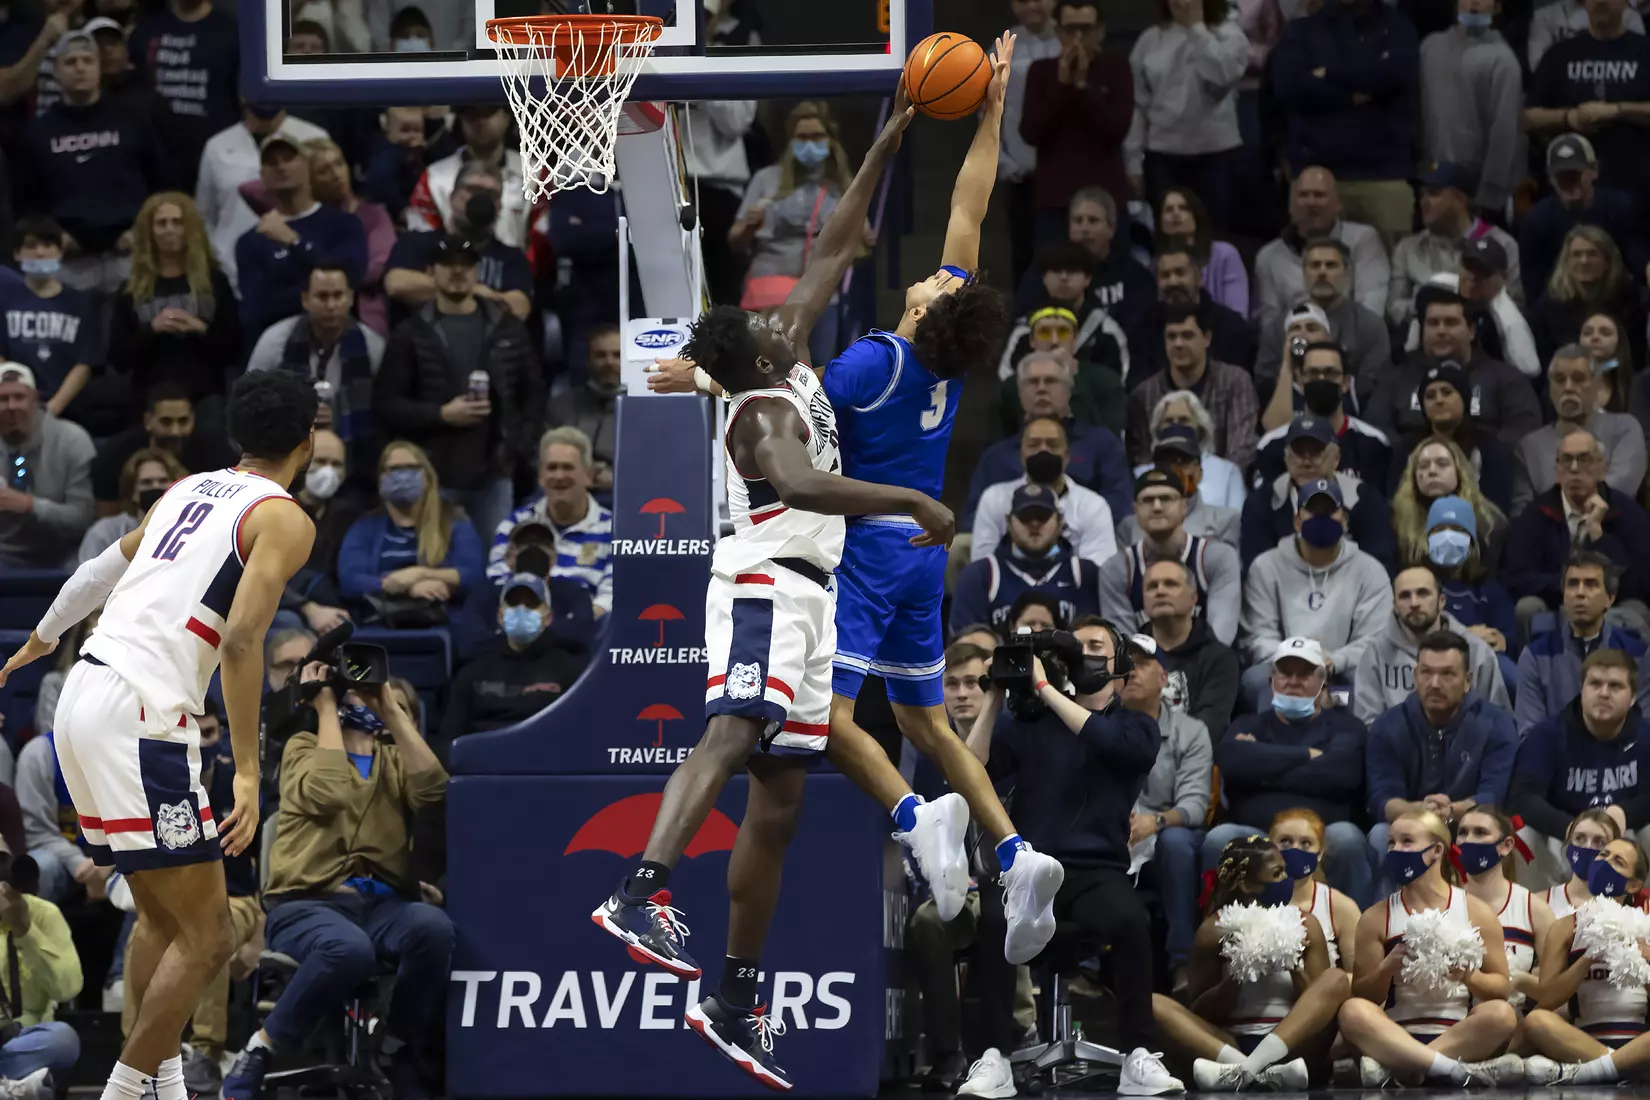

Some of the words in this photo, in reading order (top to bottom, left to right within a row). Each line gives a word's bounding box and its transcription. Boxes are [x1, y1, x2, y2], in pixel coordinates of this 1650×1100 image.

[1567, 61, 1638, 81] UCONN
[6, 310, 81, 344] UCONN
[920, 380, 949, 431] 3
[151, 501, 214, 561] 12
[612, 539, 710, 556] TRAVELERS
[609, 647, 708, 664] TRAVELERS
[1385, 663, 1415, 691] UC
[607, 747, 694, 764] TRAVELE
[1566, 766, 1598, 794] WE
[635, 867, 655, 879] 23
[736, 967, 756, 979] 23
[450, 970, 856, 1030] TRAVERS
